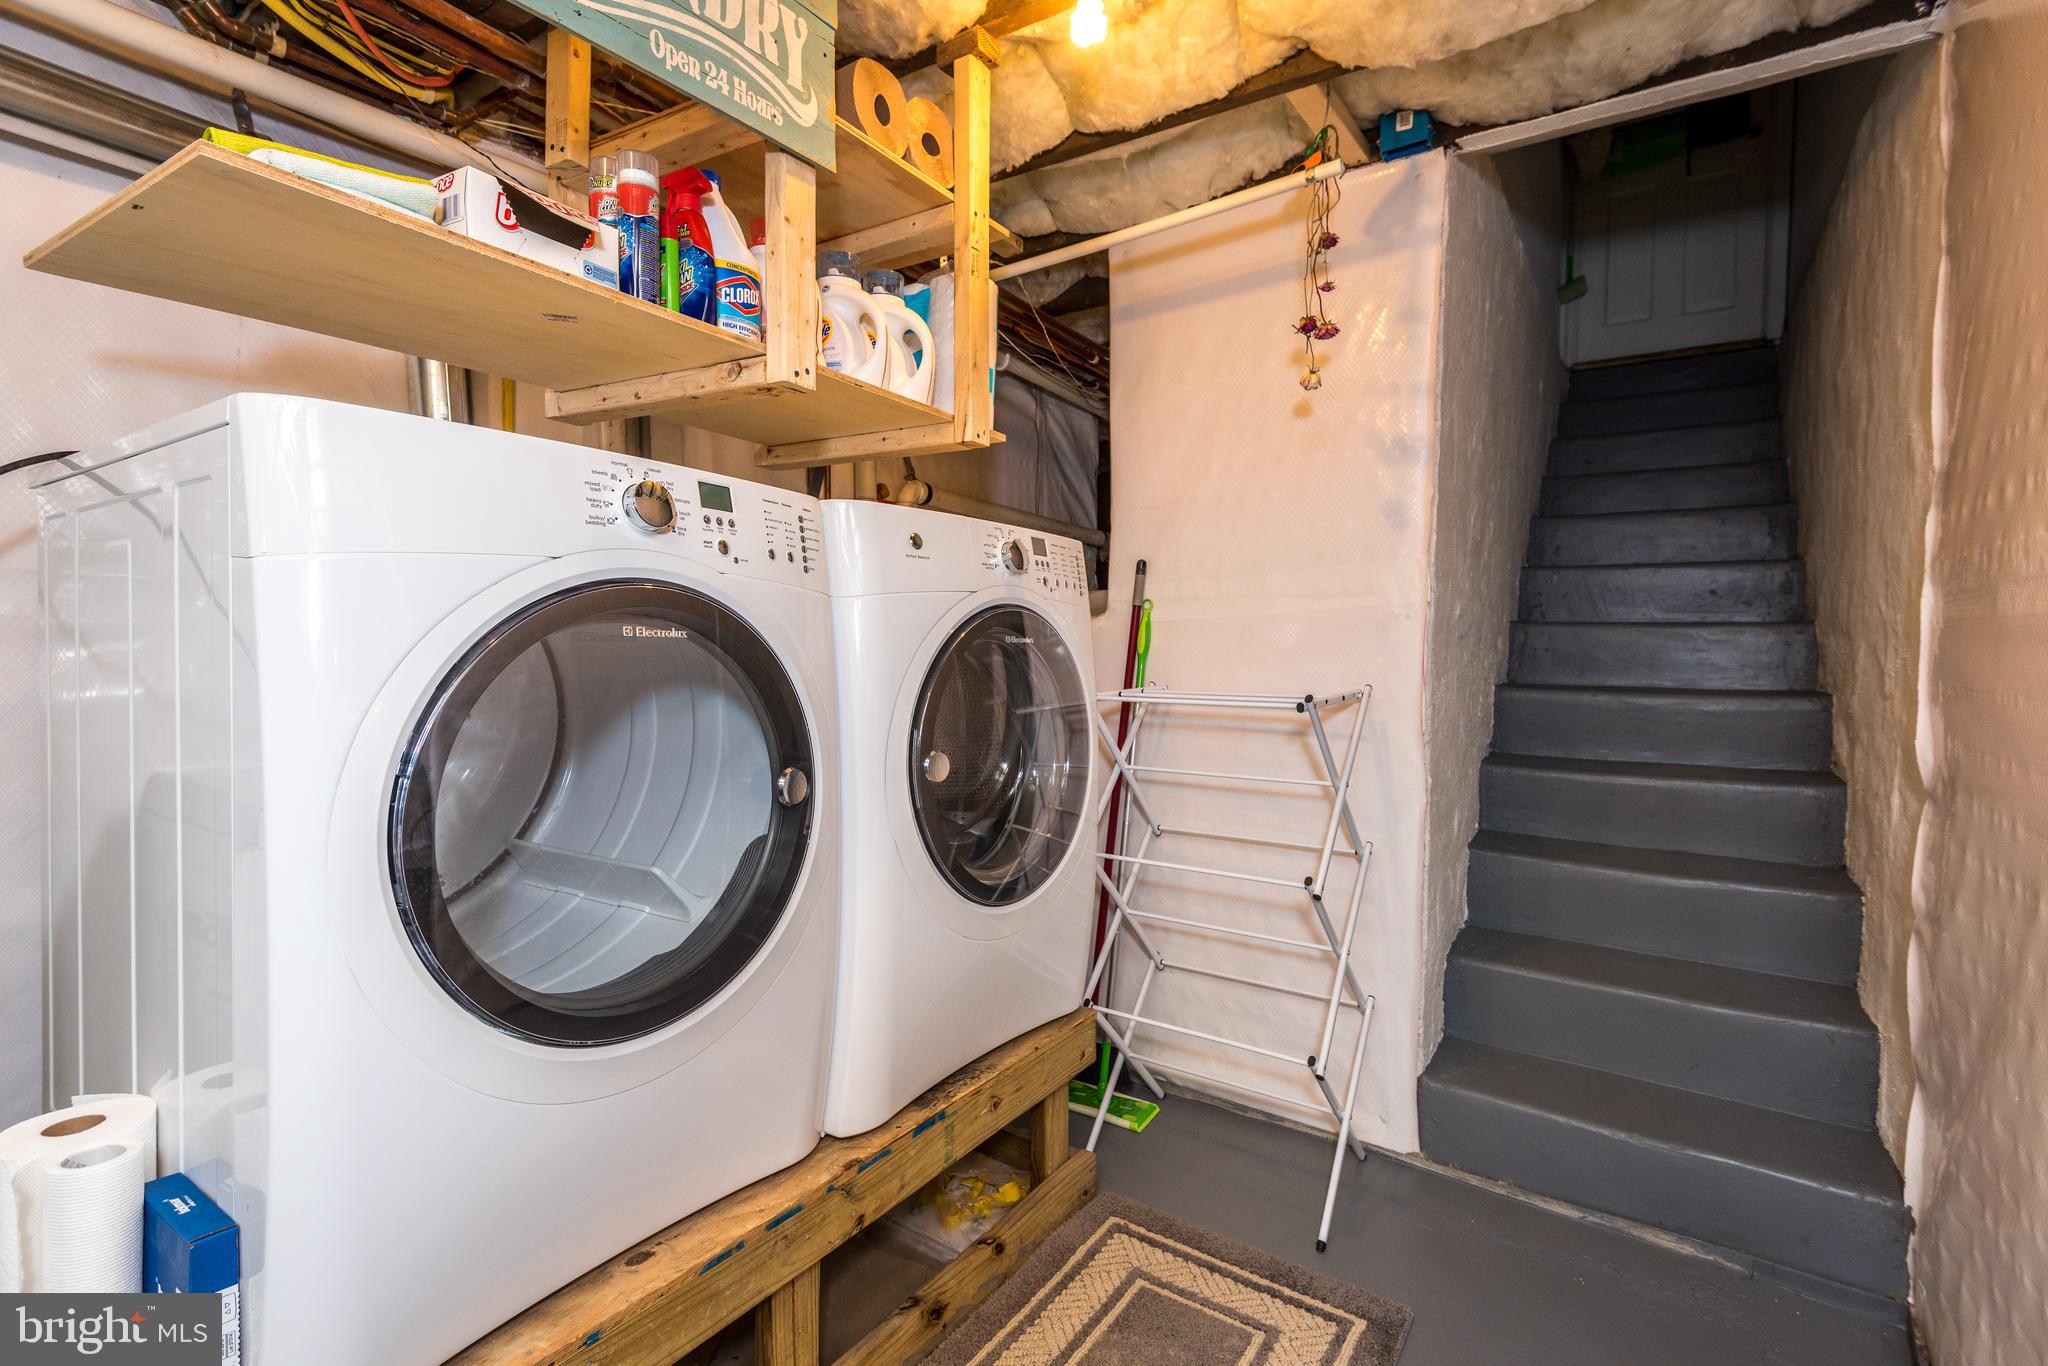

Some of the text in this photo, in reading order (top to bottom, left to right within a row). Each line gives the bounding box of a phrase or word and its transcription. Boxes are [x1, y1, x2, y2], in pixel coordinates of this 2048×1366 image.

[649, 29, 784, 127] Open 24 Hours
[721, 287, 760, 305] CLOROX
[722, 321, 738, 330] HIGH
[586, 497, 603, 505] heavy
[635, 625, 688, 638] Electrolux
